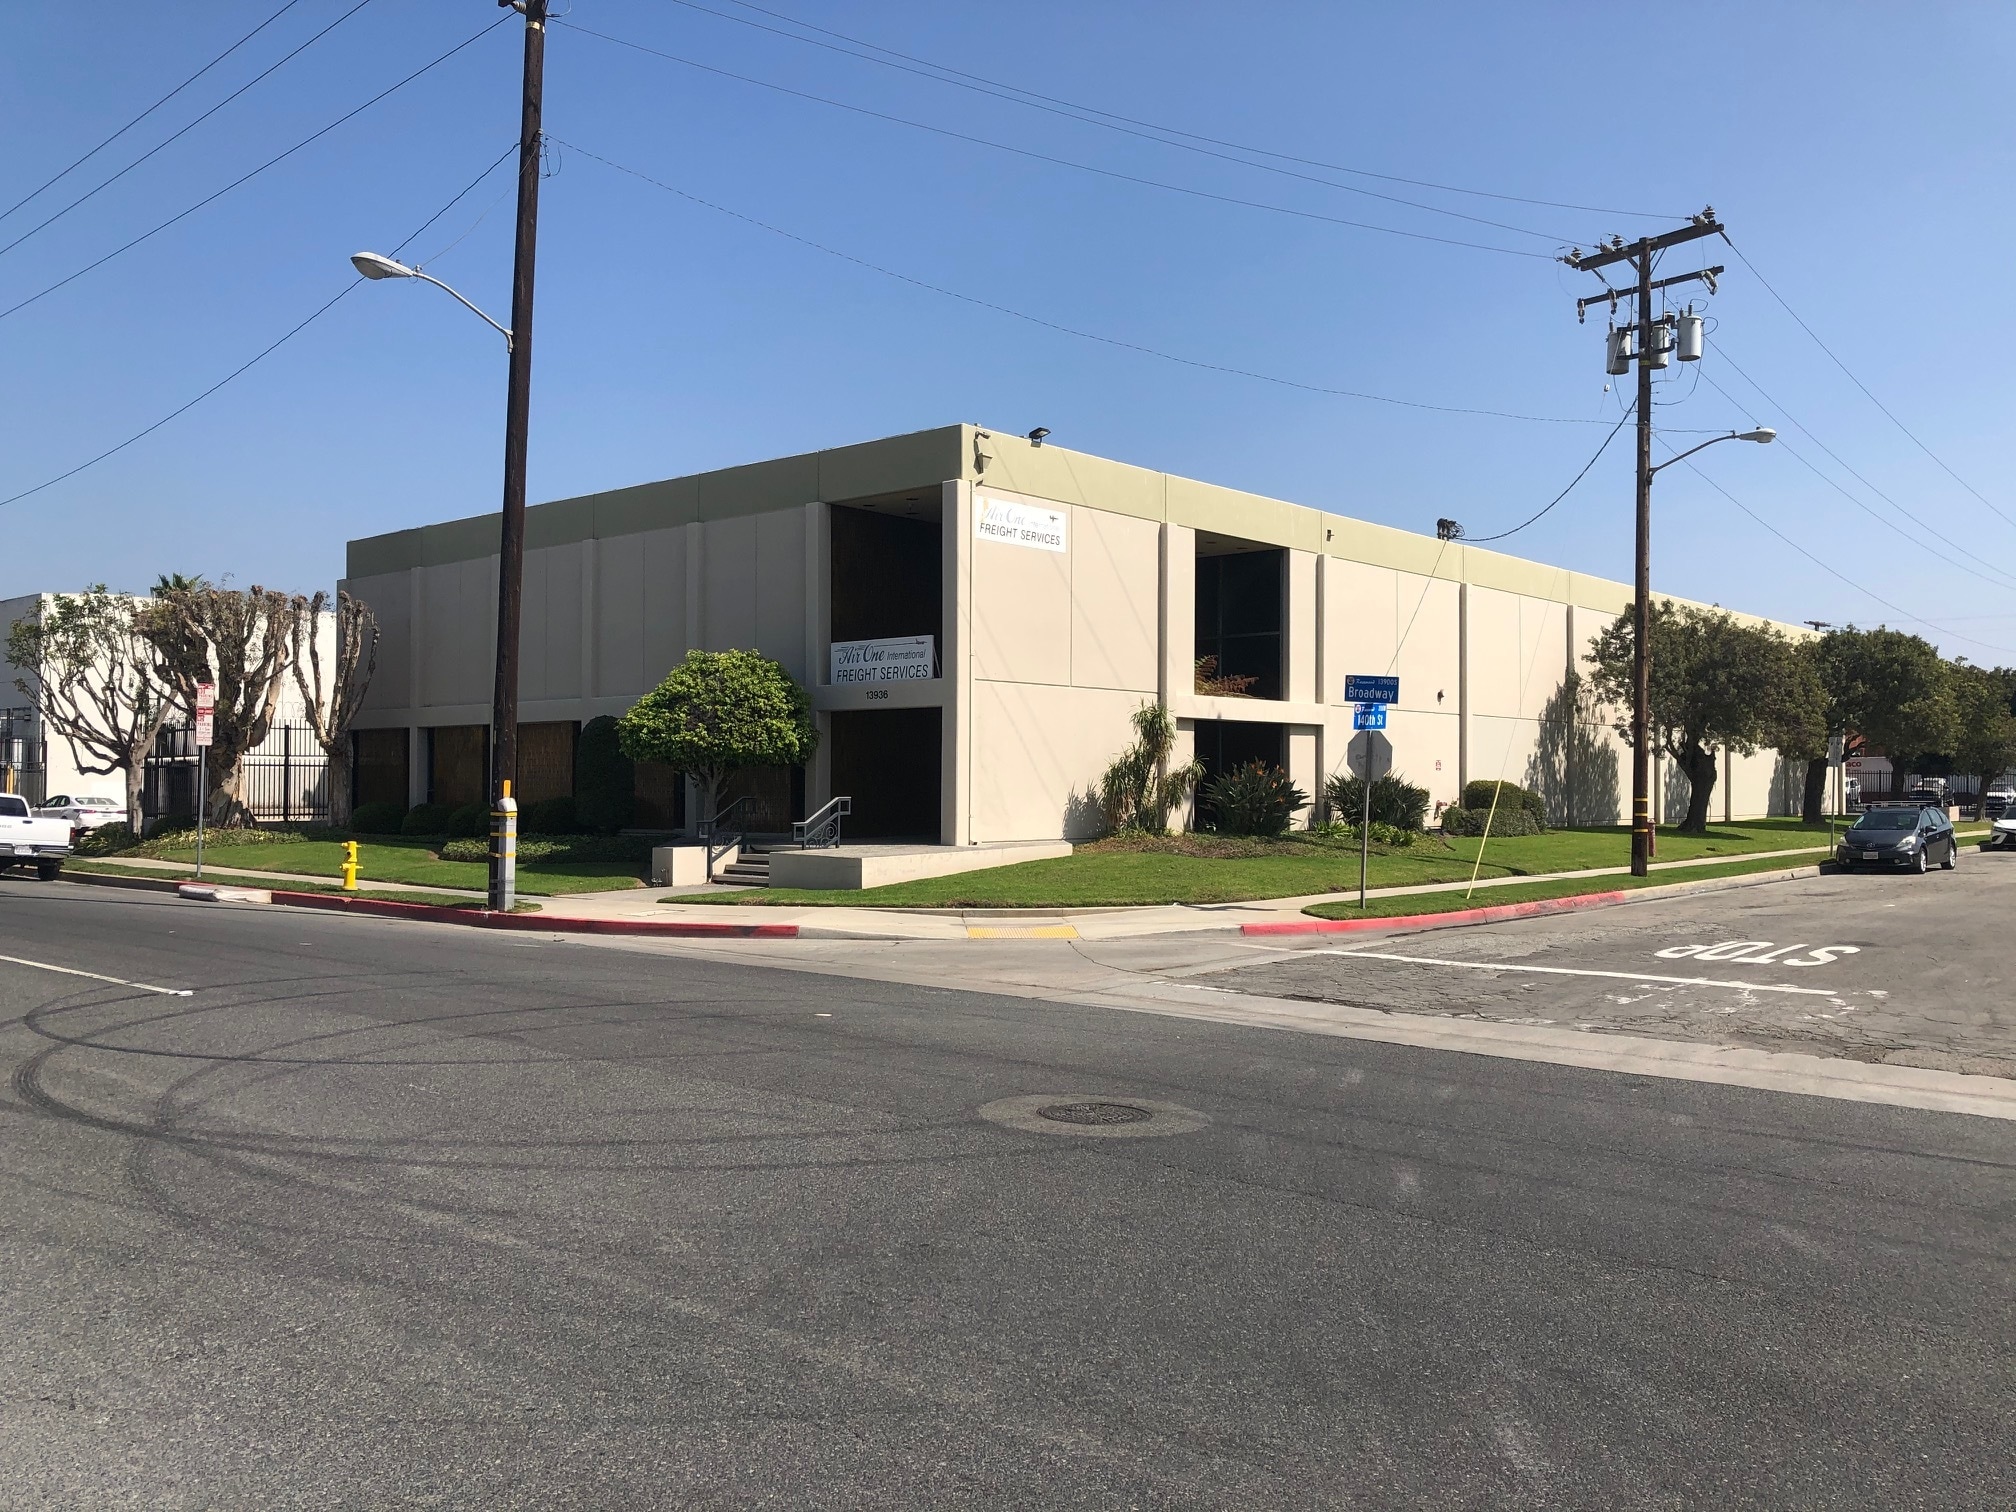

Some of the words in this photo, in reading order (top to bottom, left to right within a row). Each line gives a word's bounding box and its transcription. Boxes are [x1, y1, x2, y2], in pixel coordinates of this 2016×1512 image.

[979, 522, 1018, 539] FREIGHT
[1020, 529, 1061, 546] SERVICES
[838, 646, 861, 665] Air
[863, 643, 885, 662] One
[886, 648, 927, 661] International
[836, 667, 878, 683] FREIGHT
[879, 664, 929, 680] SERVICES
[865, 689, 889, 700] 13936
[1348, 686, 1394, 702] Broadway
[1358, 714, 1376, 726] 140th
[1376, 714, 1384, 726] St
[1654, 941, 1861, 967] STOP
